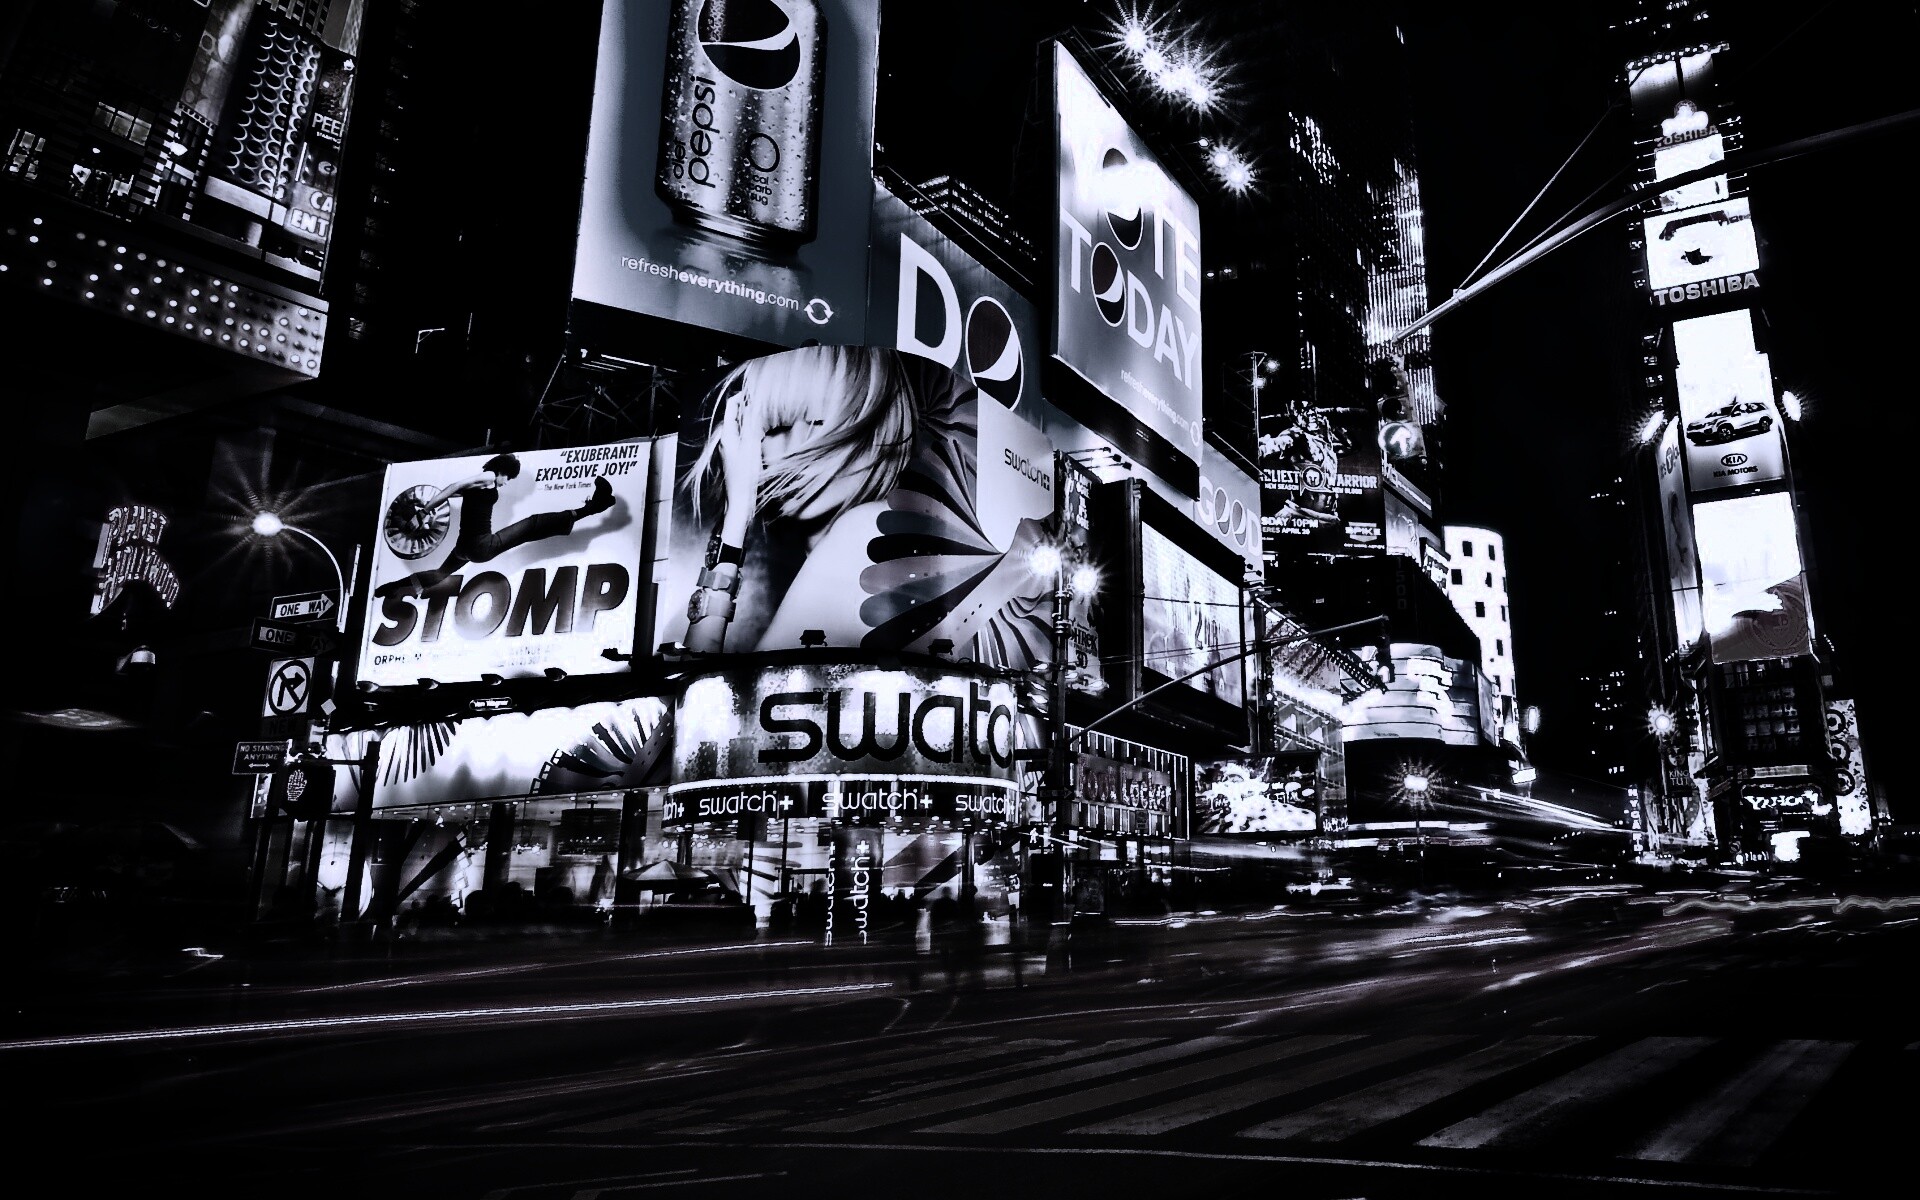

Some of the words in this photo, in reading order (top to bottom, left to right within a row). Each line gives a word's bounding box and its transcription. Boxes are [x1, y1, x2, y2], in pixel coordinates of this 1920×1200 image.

[688, 75, 721, 189] pepsi
[620, 253, 800, 311] refresheverything.com
[1654, 271, 1761, 306] TOSHIBA
[1061, 206, 1199, 391] TODAY
[1726, 455, 1744, 465] KIA
[535, 463, 599, 482] EXPLOSIVE
[1713, 470, 1726, 478] KIA
[1727, 465, 1758, 476] MOTORS
[544, 483, 552, 491] The
[566, 482, 577, 490] York
[578, 481, 592, 489] Times
[1277, 483, 1300, 491] SEASON
[1326, 473, 1378, 489] WARRIOR
[1281, 527, 1300, 535] APRIL
[1292, 518, 1319, 528] 10PM
[280, 603, 301, 616] ONE
[308, 599, 329, 613] WAY
[372, 562, 630, 647] STOMP
[265, 628, 294, 644] ONE
[758, 681, 1016, 769] swatc
[240, 744, 251, 752] NO
[252, 744, 285, 753] STANDING
[243, 753, 279, 761] ANYTIME
[1669, 769, 1690, 778] KING
[1670, 777, 1689, 786] TUT
[698, 790, 777, 817] swatch
[821, 788, 918, 811] swatch
